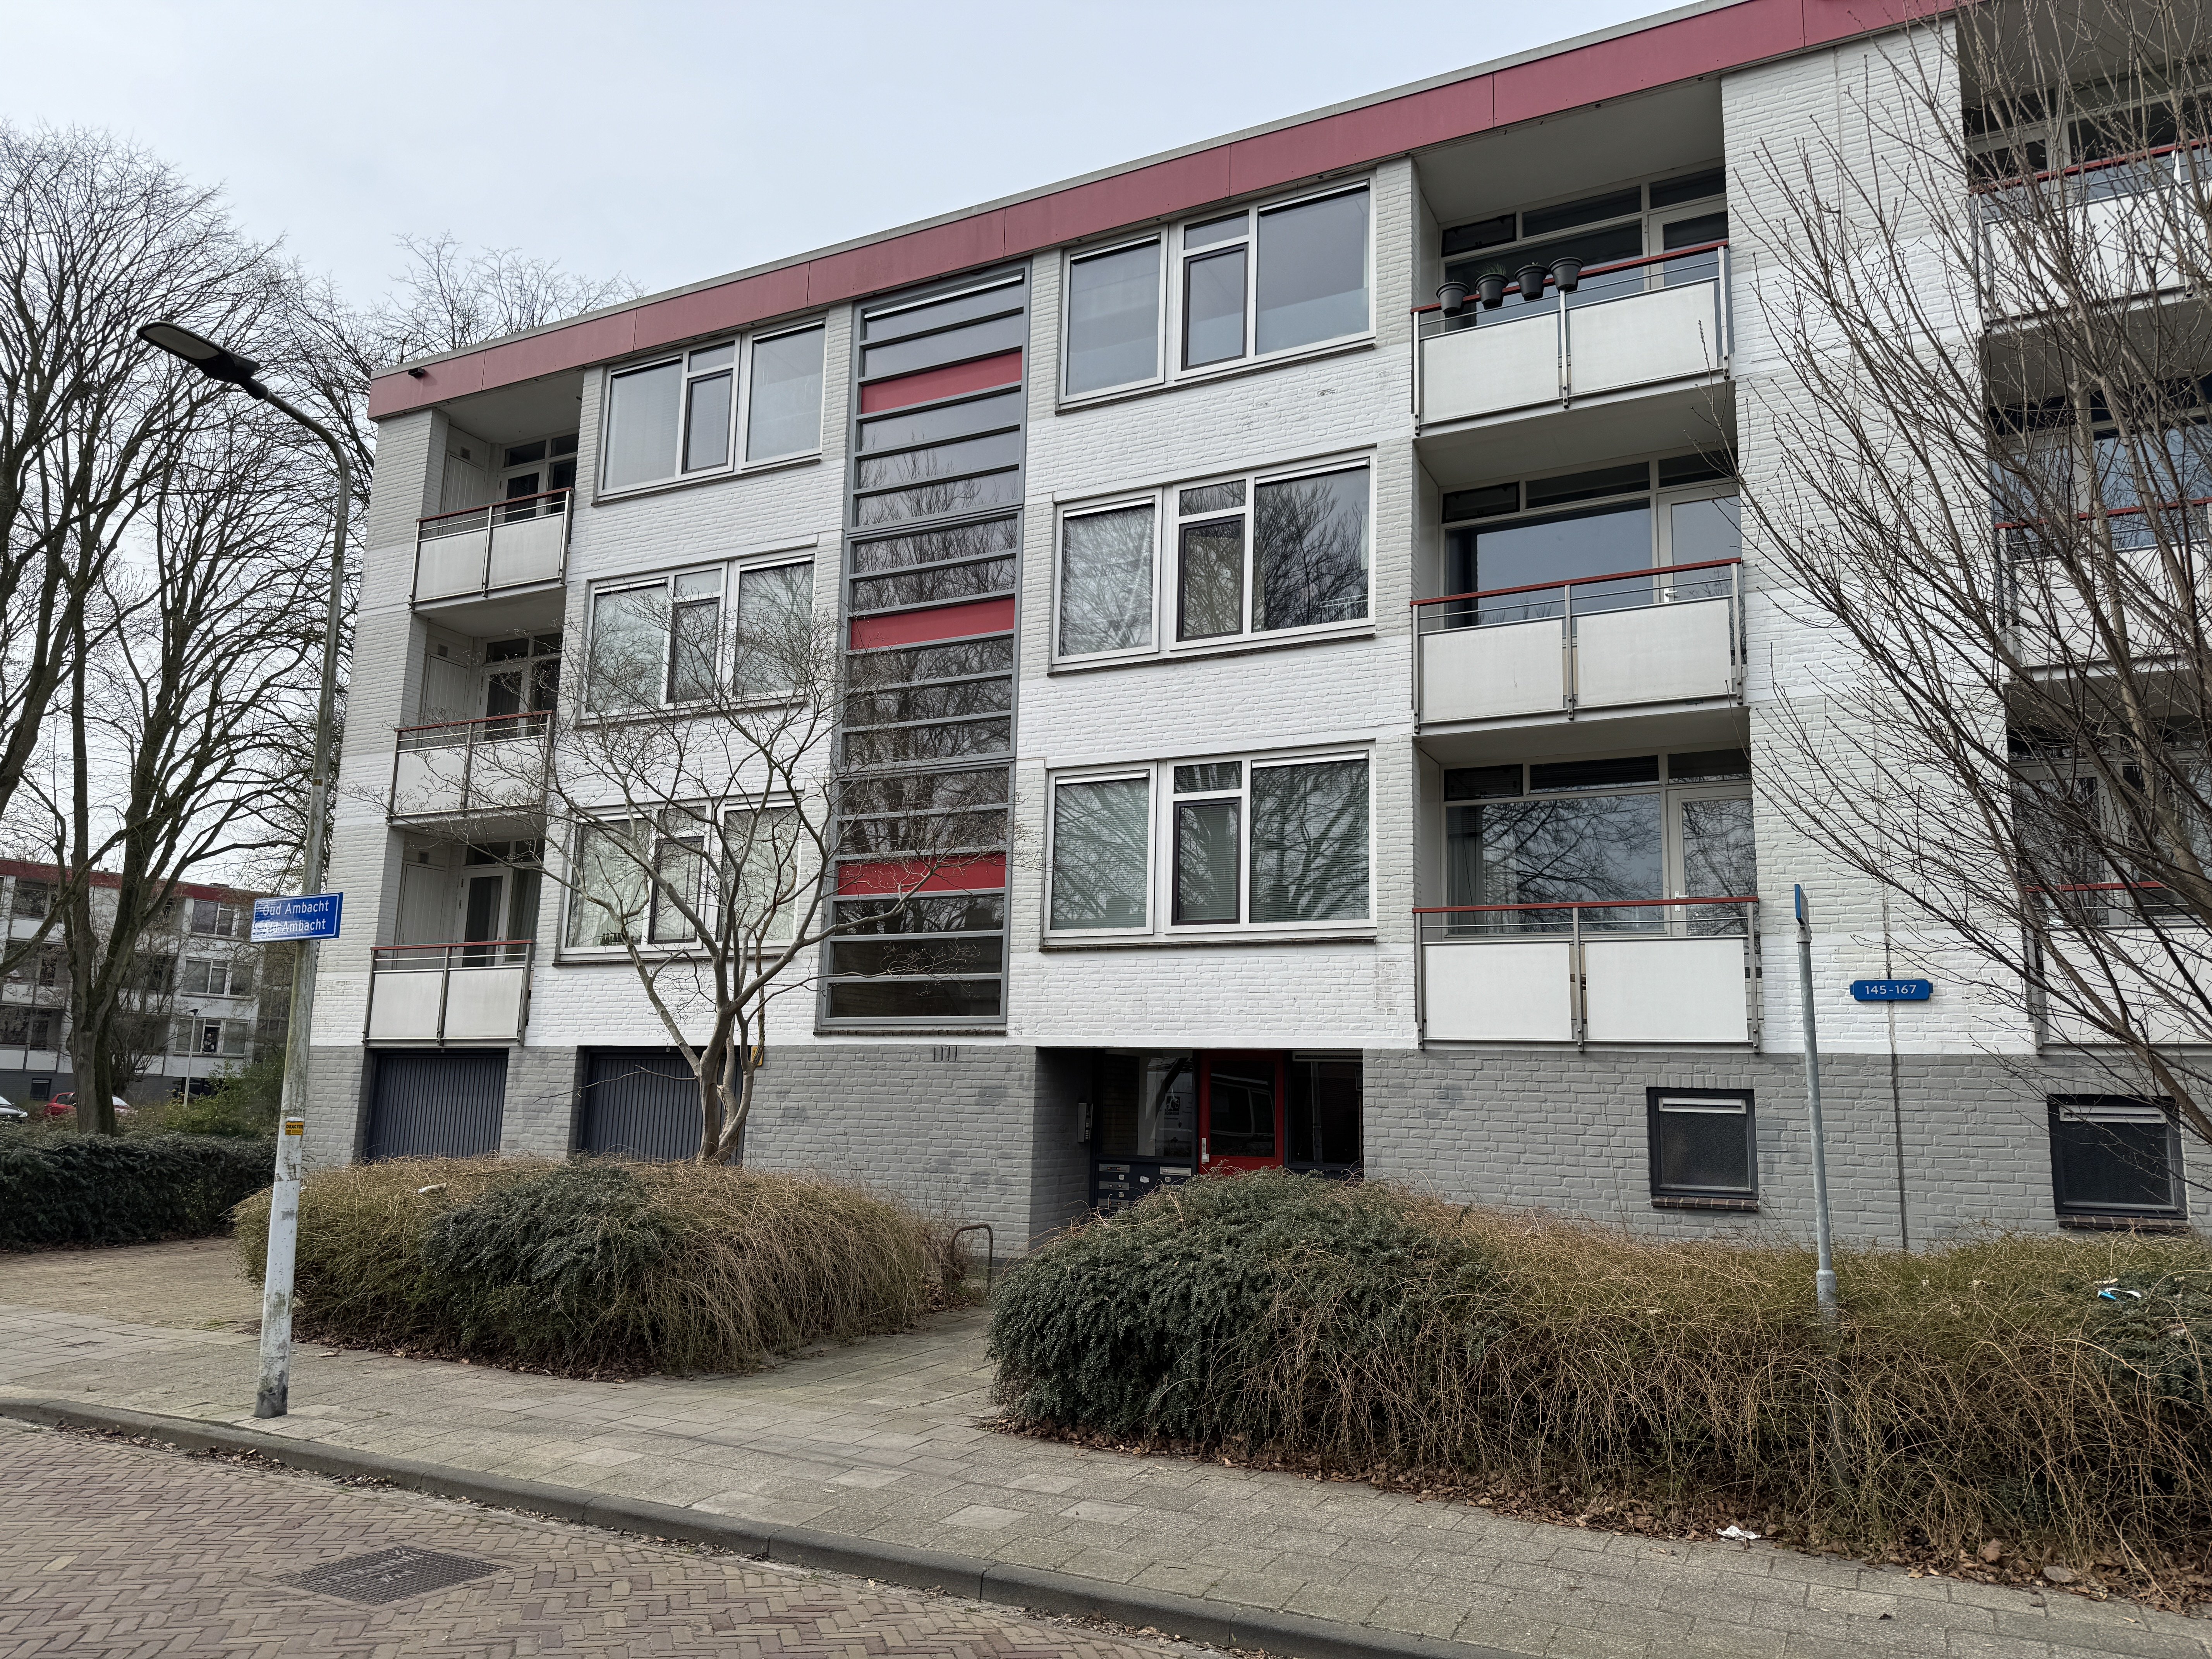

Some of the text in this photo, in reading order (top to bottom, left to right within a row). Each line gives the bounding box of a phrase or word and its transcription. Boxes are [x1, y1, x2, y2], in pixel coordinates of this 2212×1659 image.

[263, 900, 329, 916] Oud Ambacht
[282, 918, 326, 932] Ambacht
[1865, 984, 1917, 994] 145-167
